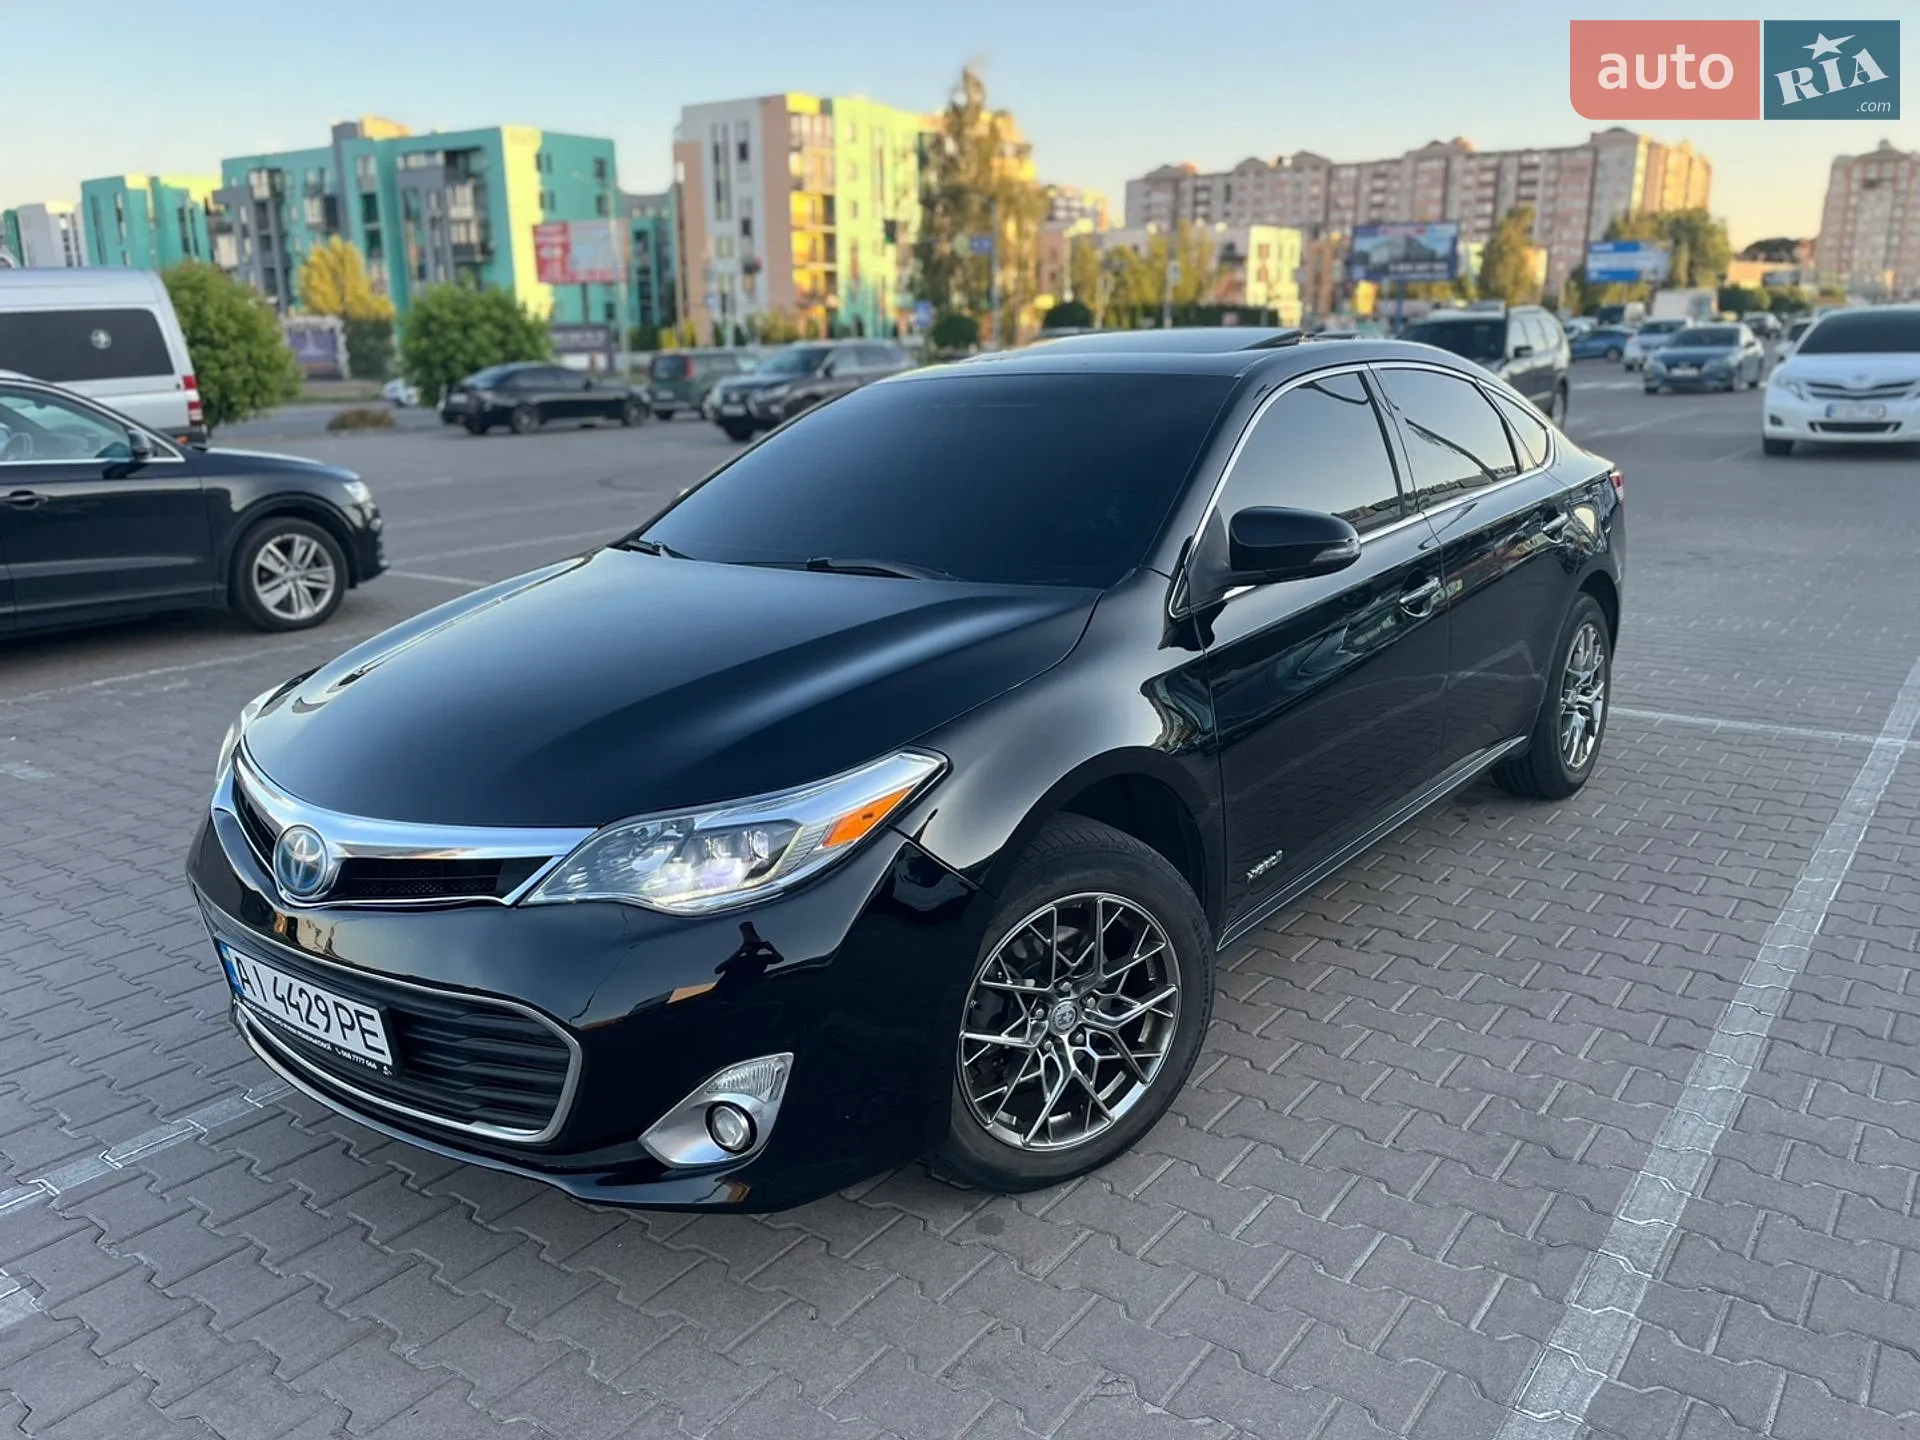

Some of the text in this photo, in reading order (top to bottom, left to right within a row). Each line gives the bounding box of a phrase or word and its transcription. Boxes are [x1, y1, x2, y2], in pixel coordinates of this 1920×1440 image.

[235, 956, 267, 1003] AI
[273, 976, 331, 1034] 4429
[332, 1000, 387, 1056] PE
